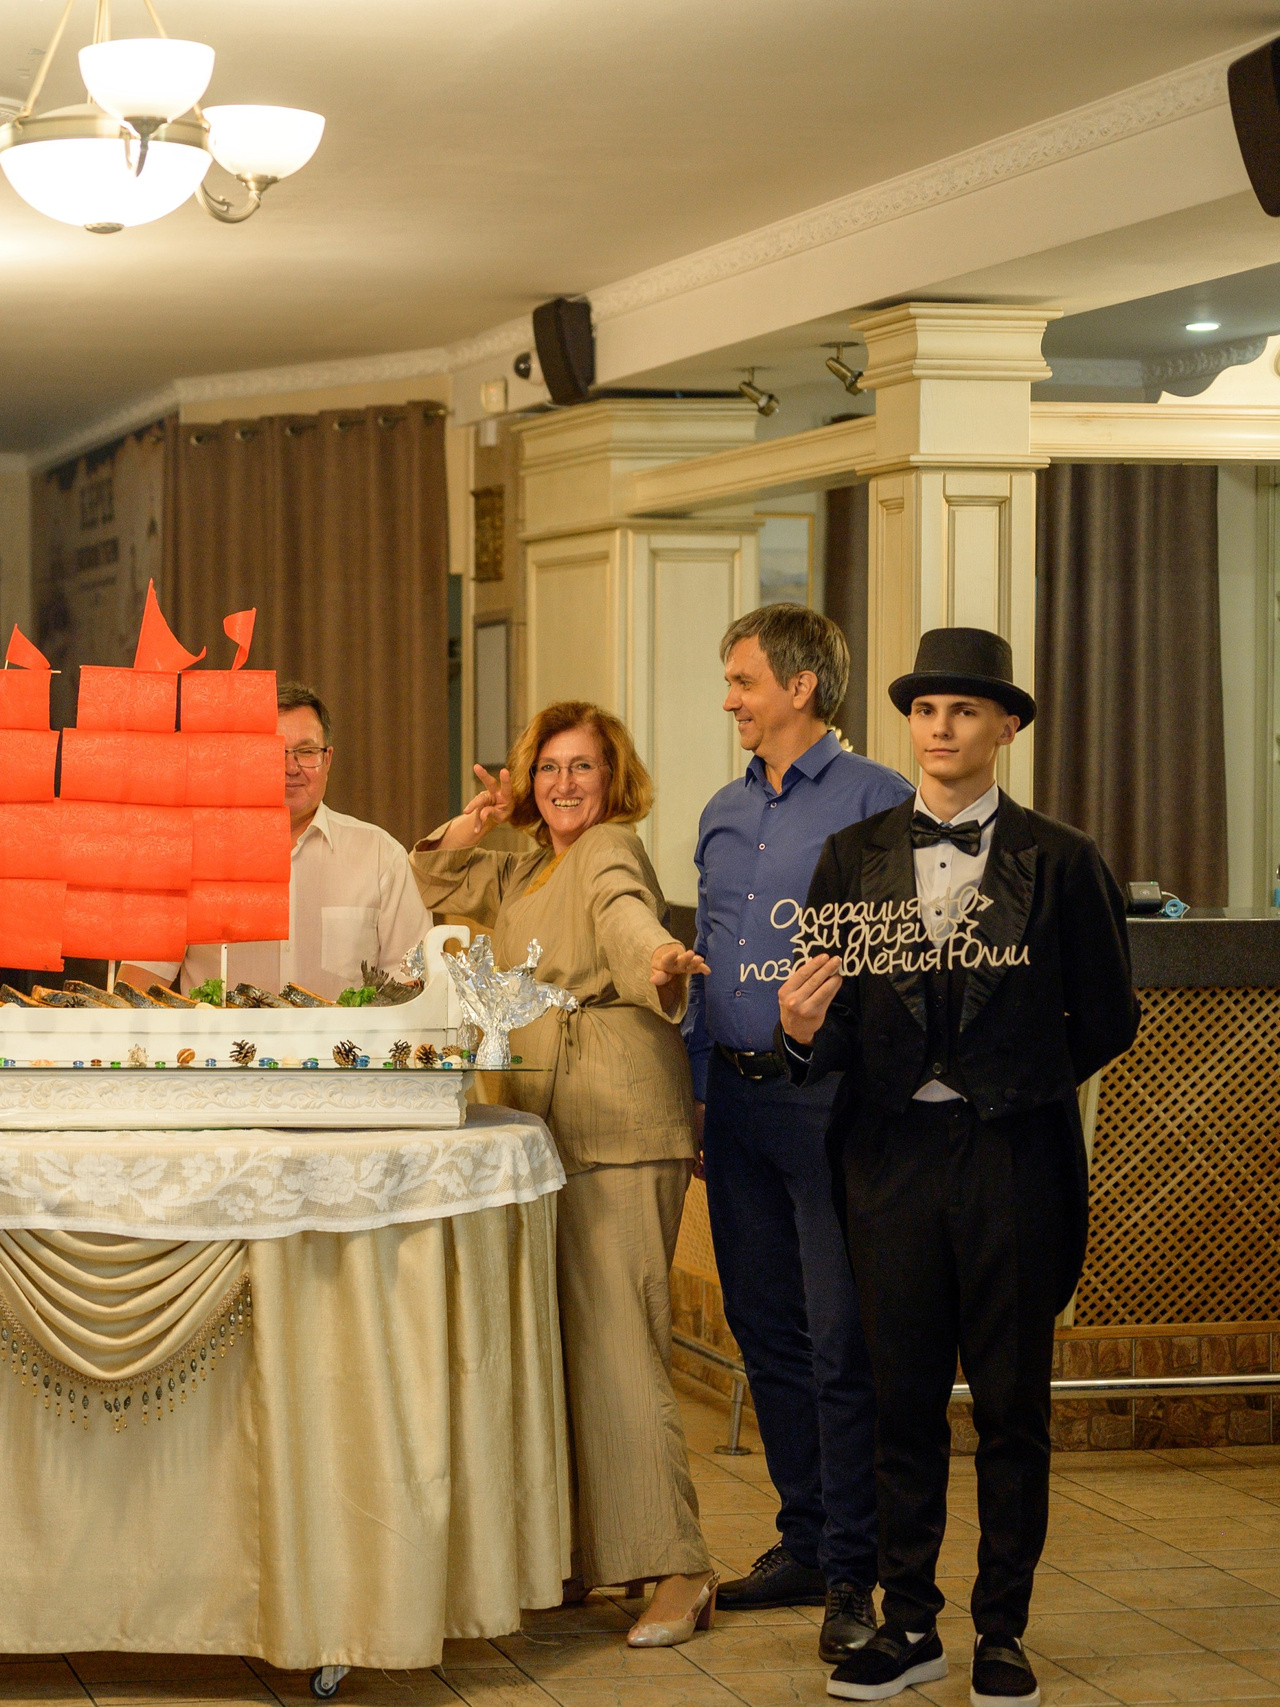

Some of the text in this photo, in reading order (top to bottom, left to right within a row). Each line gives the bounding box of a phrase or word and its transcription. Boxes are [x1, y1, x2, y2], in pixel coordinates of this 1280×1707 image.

[770, 897, 924, 936] Операция
[822, 916, 953, 955] и другие
[739, 935, 1031, 983] поздвления Юлии
